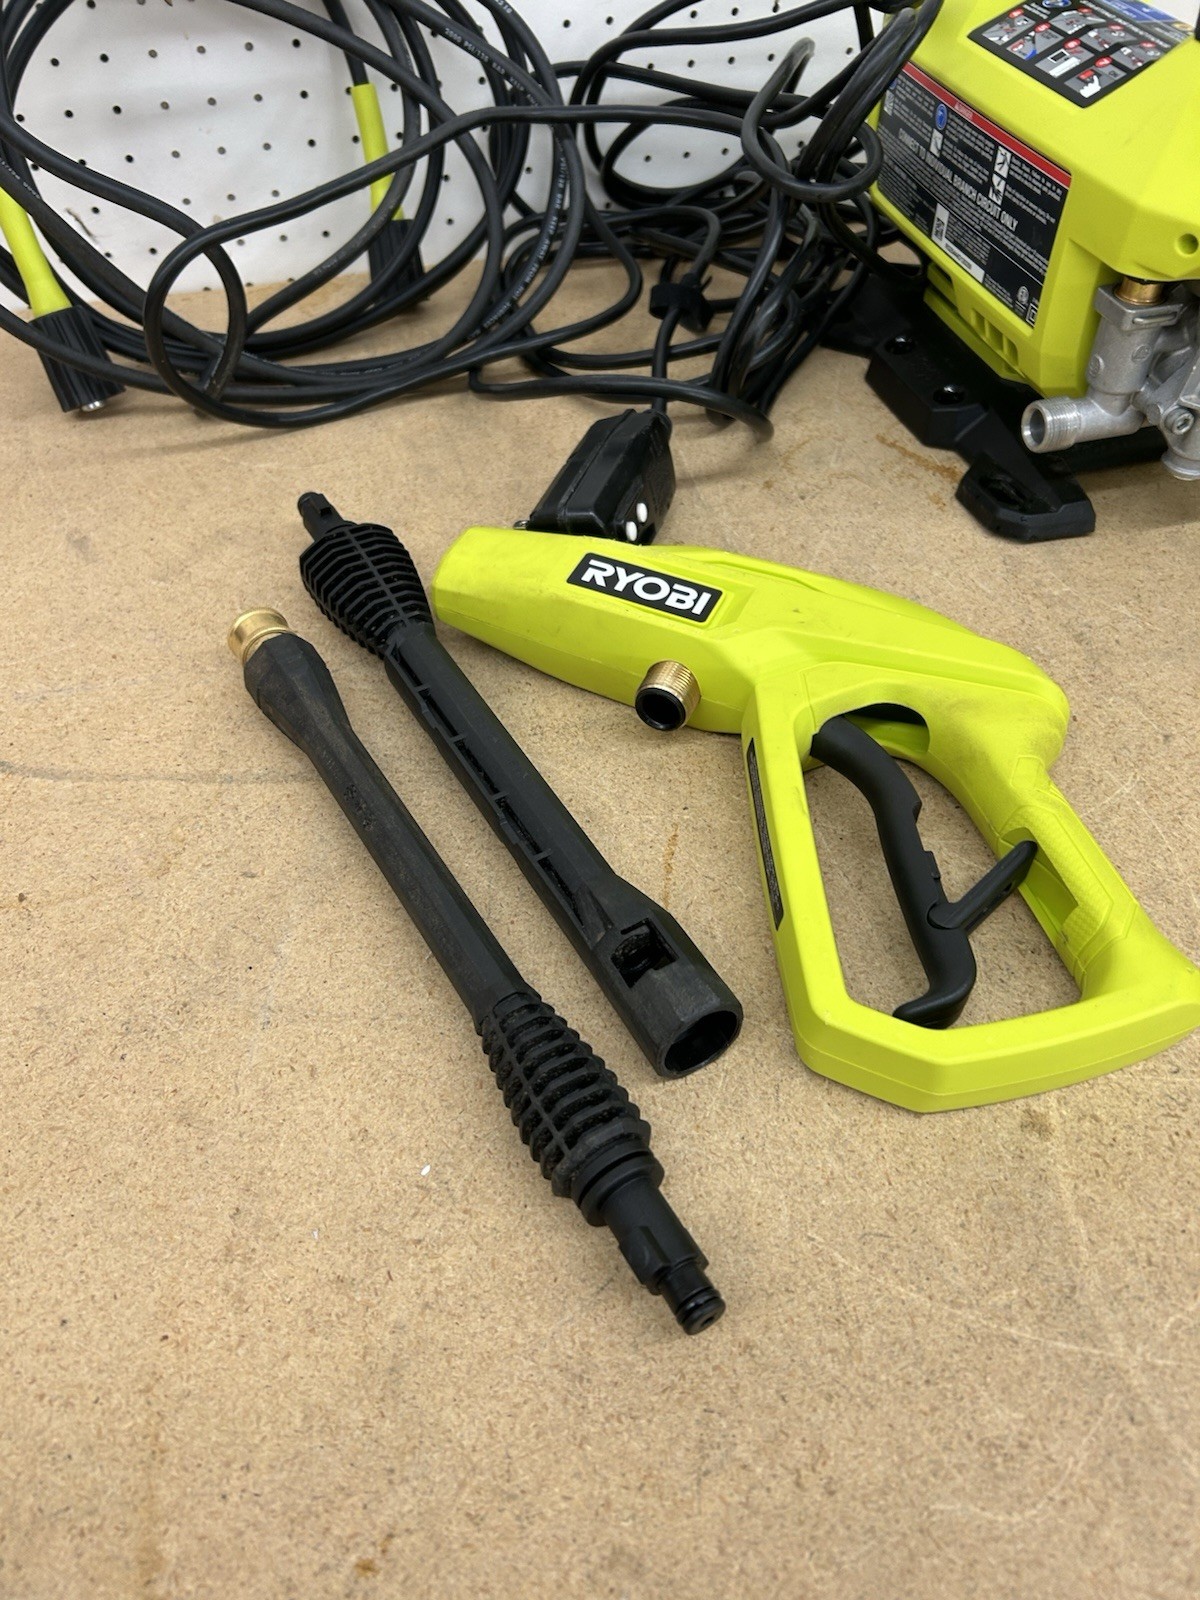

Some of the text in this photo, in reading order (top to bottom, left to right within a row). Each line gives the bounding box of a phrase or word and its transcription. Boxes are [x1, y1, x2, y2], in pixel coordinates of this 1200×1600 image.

[953, 173, 978, 202] BRANCH
[976, 192, 1001, 220] CIRCUIT
[1000, 210, 1019, 232] ONLY
[581, 559, 711, 615] RYOBI
